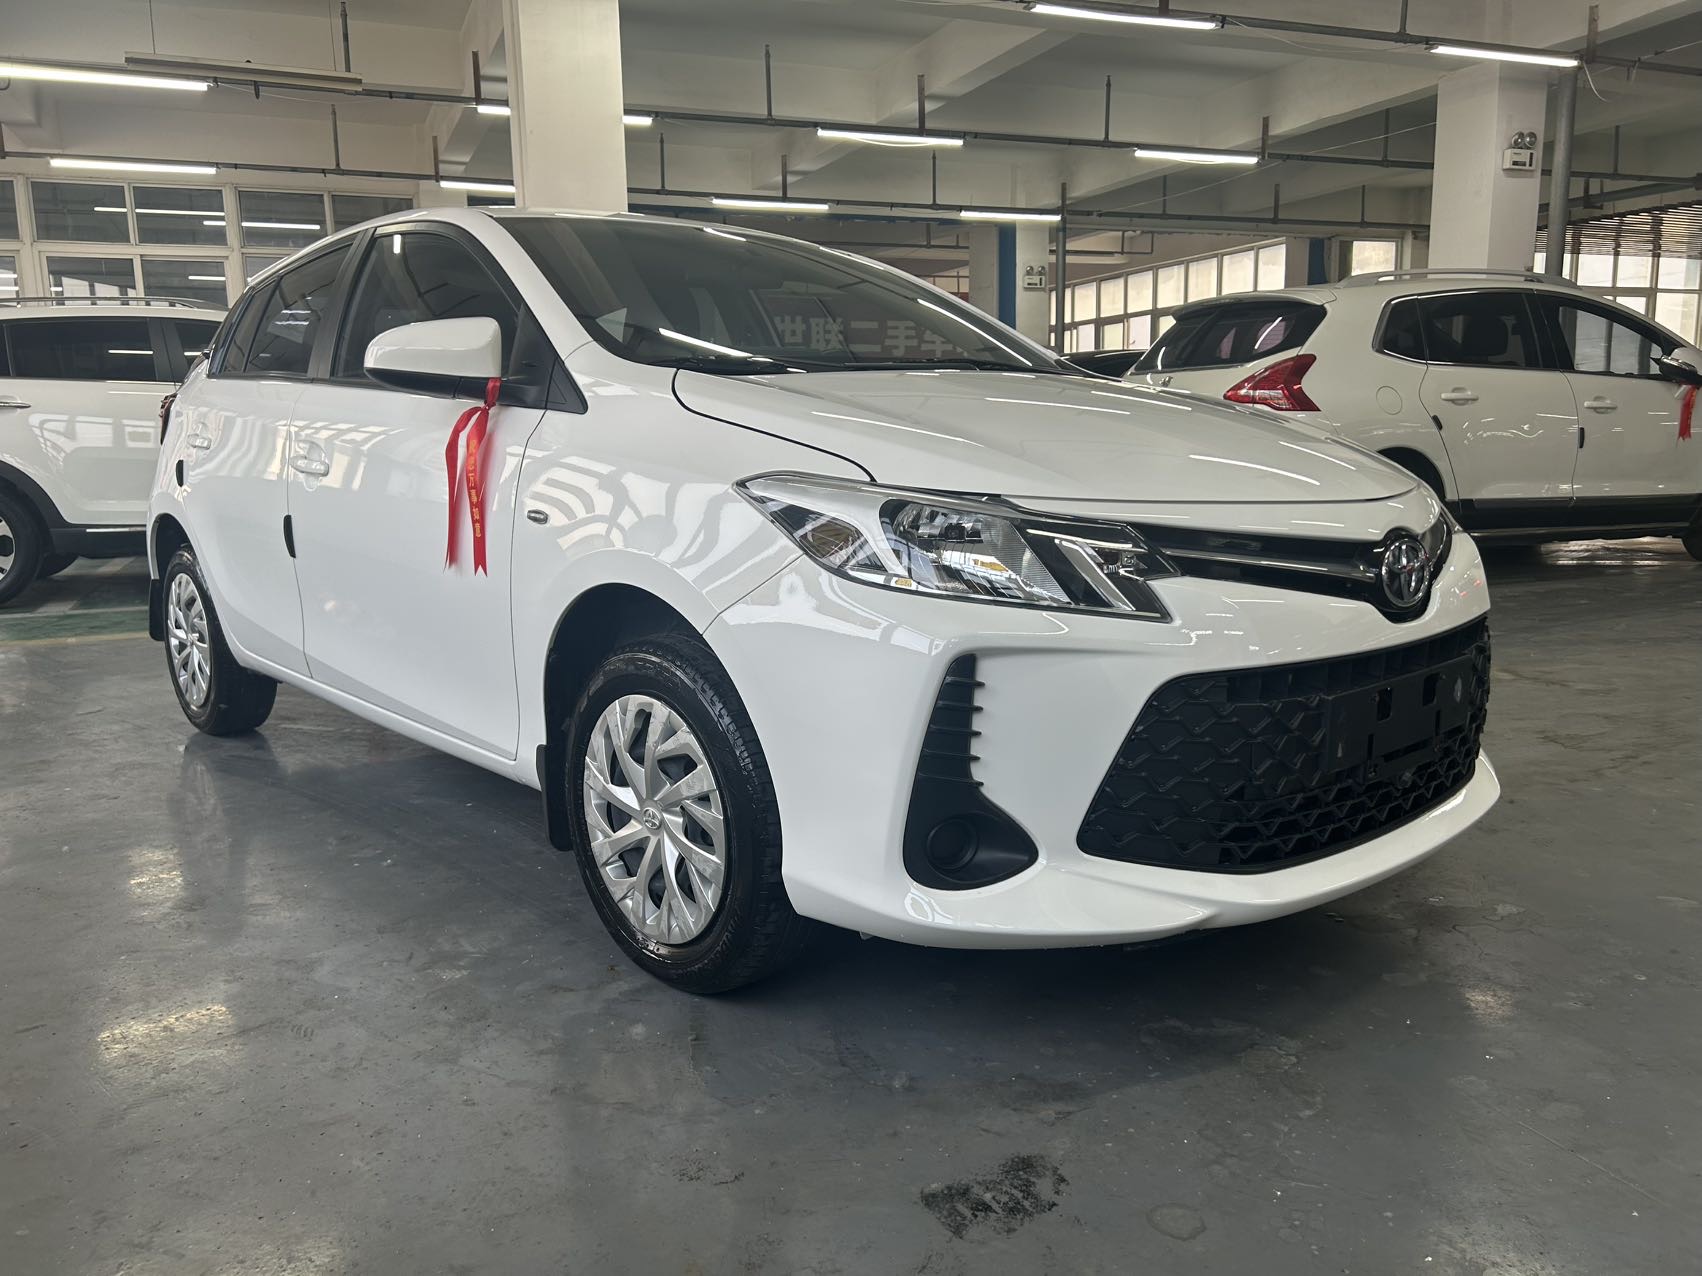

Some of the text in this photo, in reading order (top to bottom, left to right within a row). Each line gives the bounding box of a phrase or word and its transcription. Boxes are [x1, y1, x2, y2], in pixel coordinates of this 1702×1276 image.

[773, 315, 968, 358] 世联二手车
